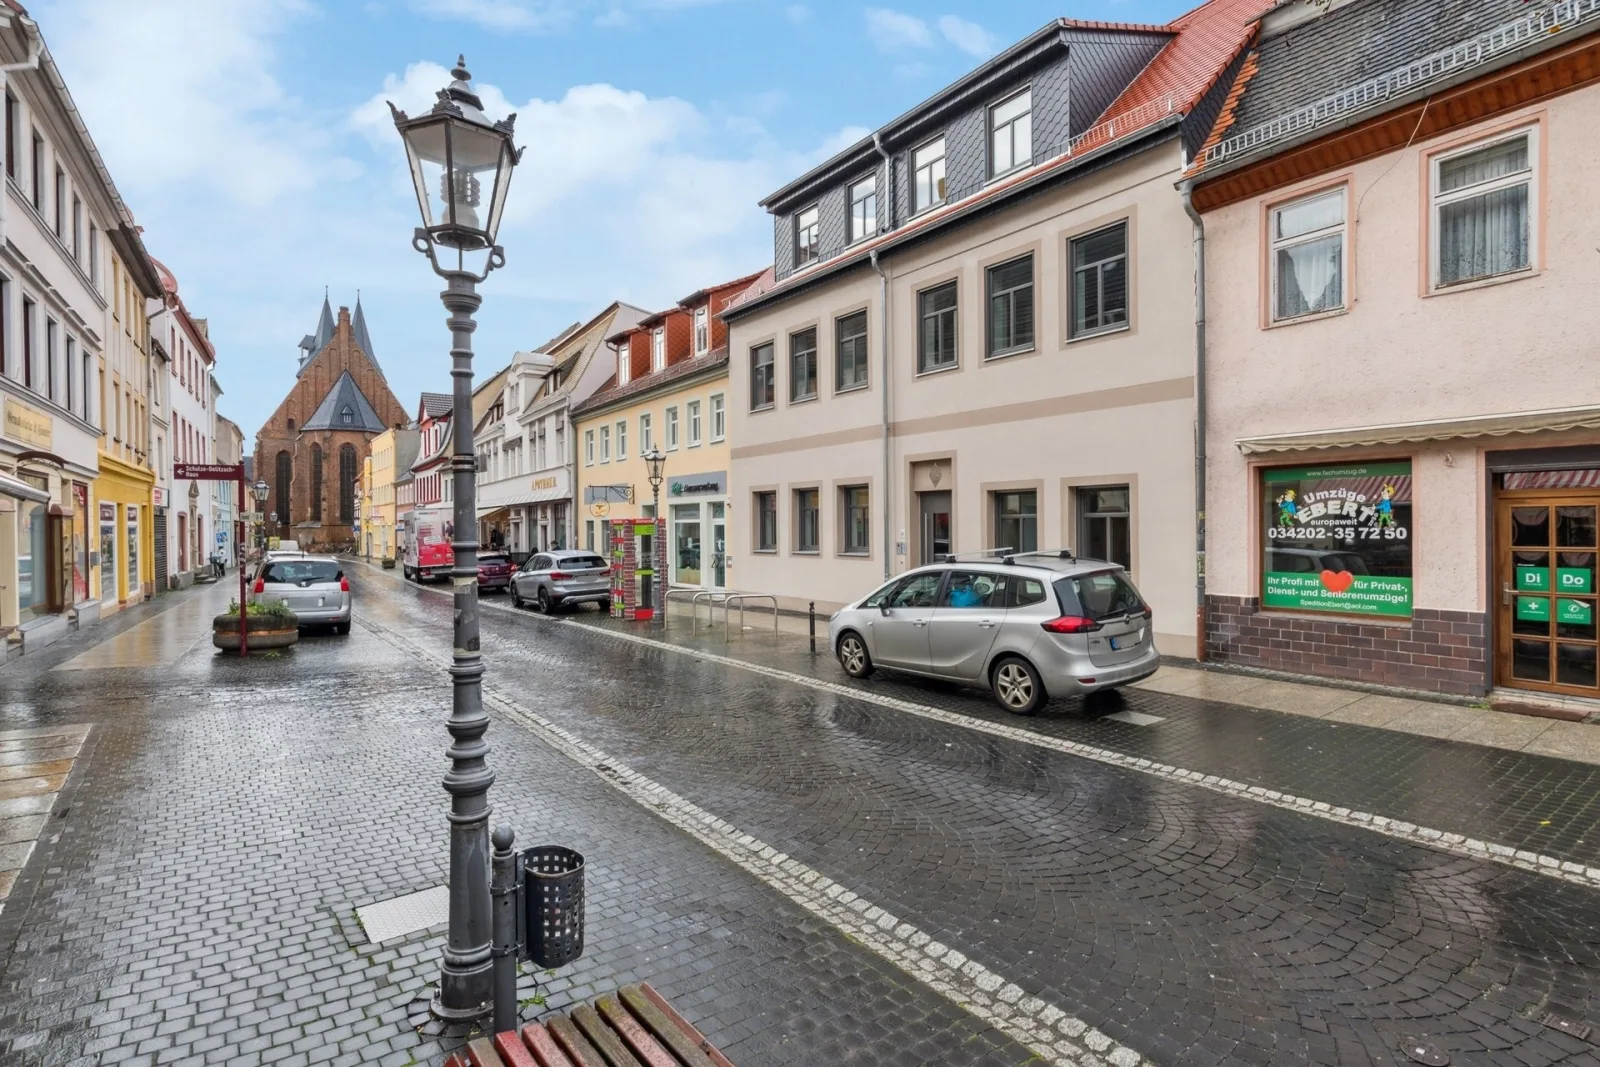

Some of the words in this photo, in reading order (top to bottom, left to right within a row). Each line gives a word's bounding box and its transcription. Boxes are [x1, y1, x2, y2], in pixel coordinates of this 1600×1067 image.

[1306, 468, 1367, 476] www.fachumzug.de
[1303, 488, 1366, 504] Umzüge
[1296, 500, 1374, 524] EBERT
[1310, 518, 1358, 526] europaweit
[1358, 527, 1380, 539] 72
[1384, 527, 1408, 539] 50
[1267, 576, 1280, 585] Ihr
[1281, 577, 1303, 586] Profi
[1304, 578, 1320, 587] mit
[1353, 580, 1369, 589] für
[1525, 572, 1540, 583] Di
[1562, 574, 1584, 585] Do
[1267, 586, 1299, 596] Dienst-
[1300, 589, 1318, 597] und
[1320, 589, 1408, 604] Seniorenumzüge!
